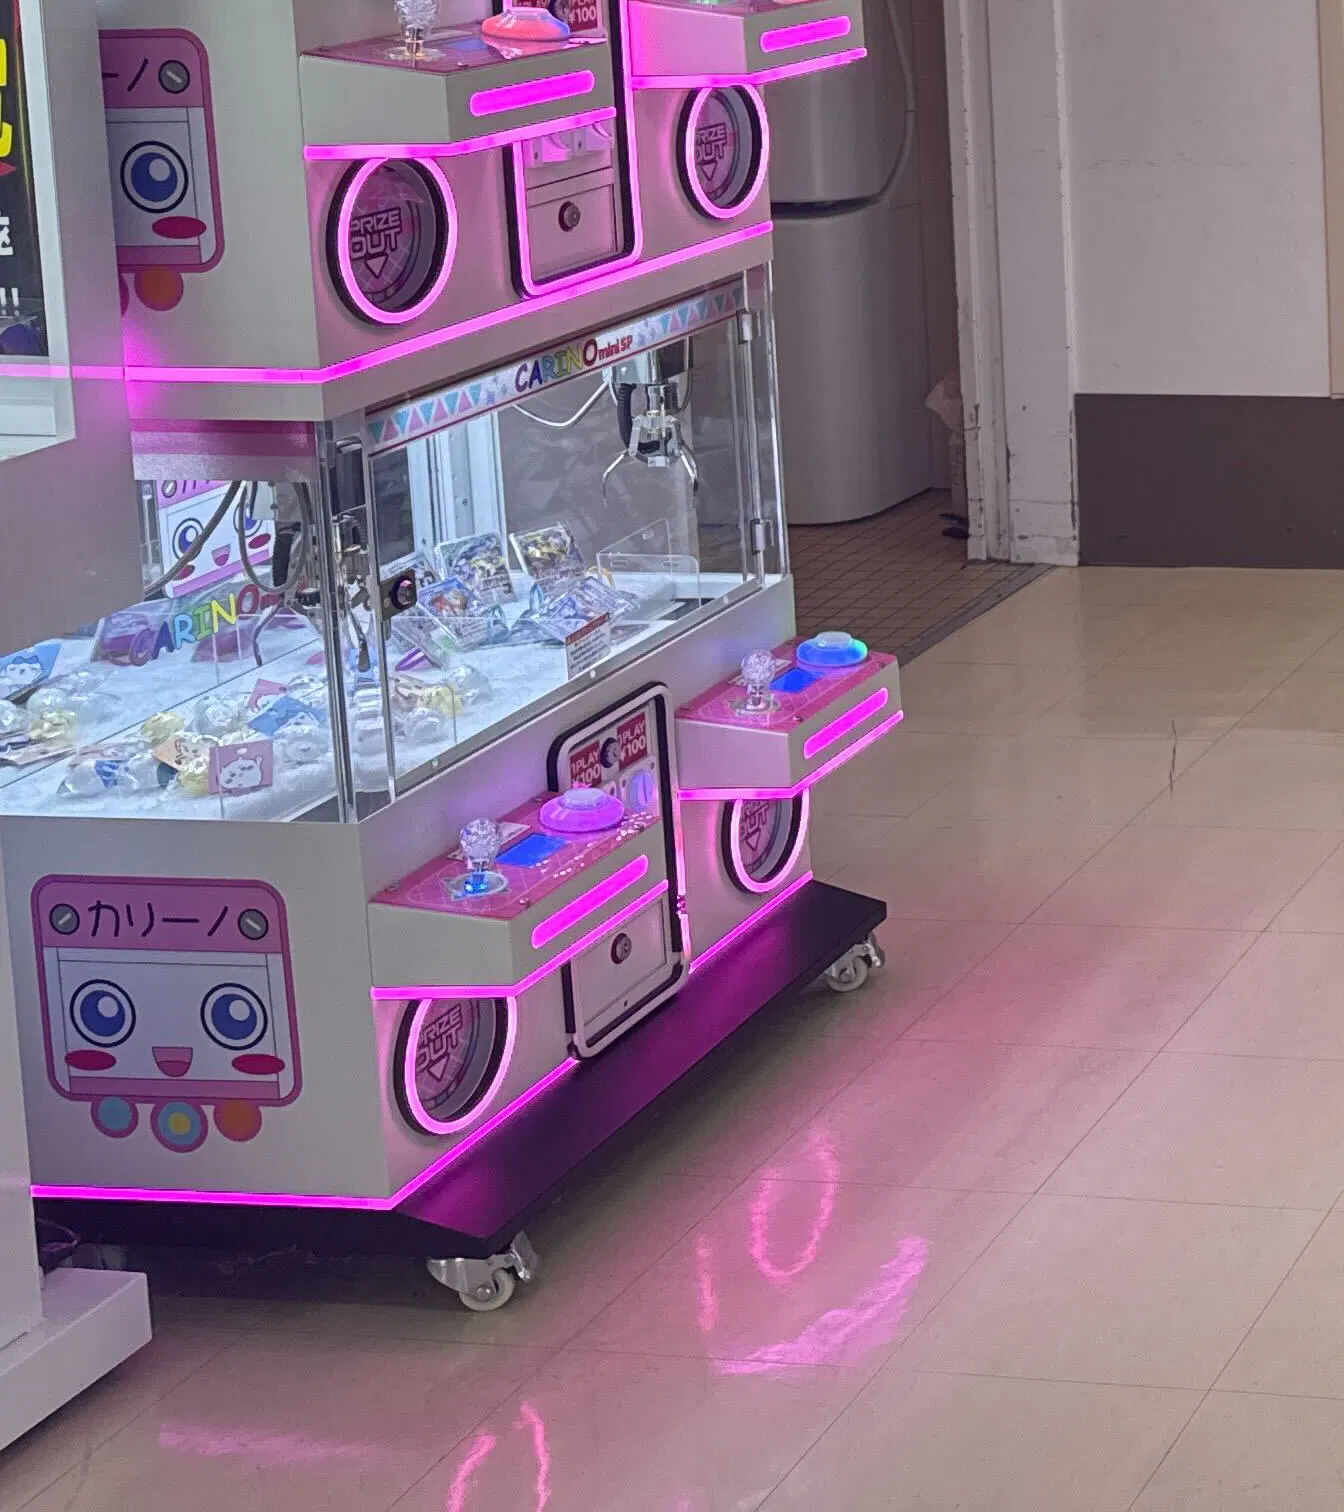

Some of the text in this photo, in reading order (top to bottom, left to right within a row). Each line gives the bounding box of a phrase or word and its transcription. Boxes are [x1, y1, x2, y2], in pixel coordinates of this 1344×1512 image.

[350, 208, 401, 235] PRIZE
[351, 227, 401, 260] OUT
[515, 338, 597, 392] CARINO
[88, 900, 229, 937] カリーノ
